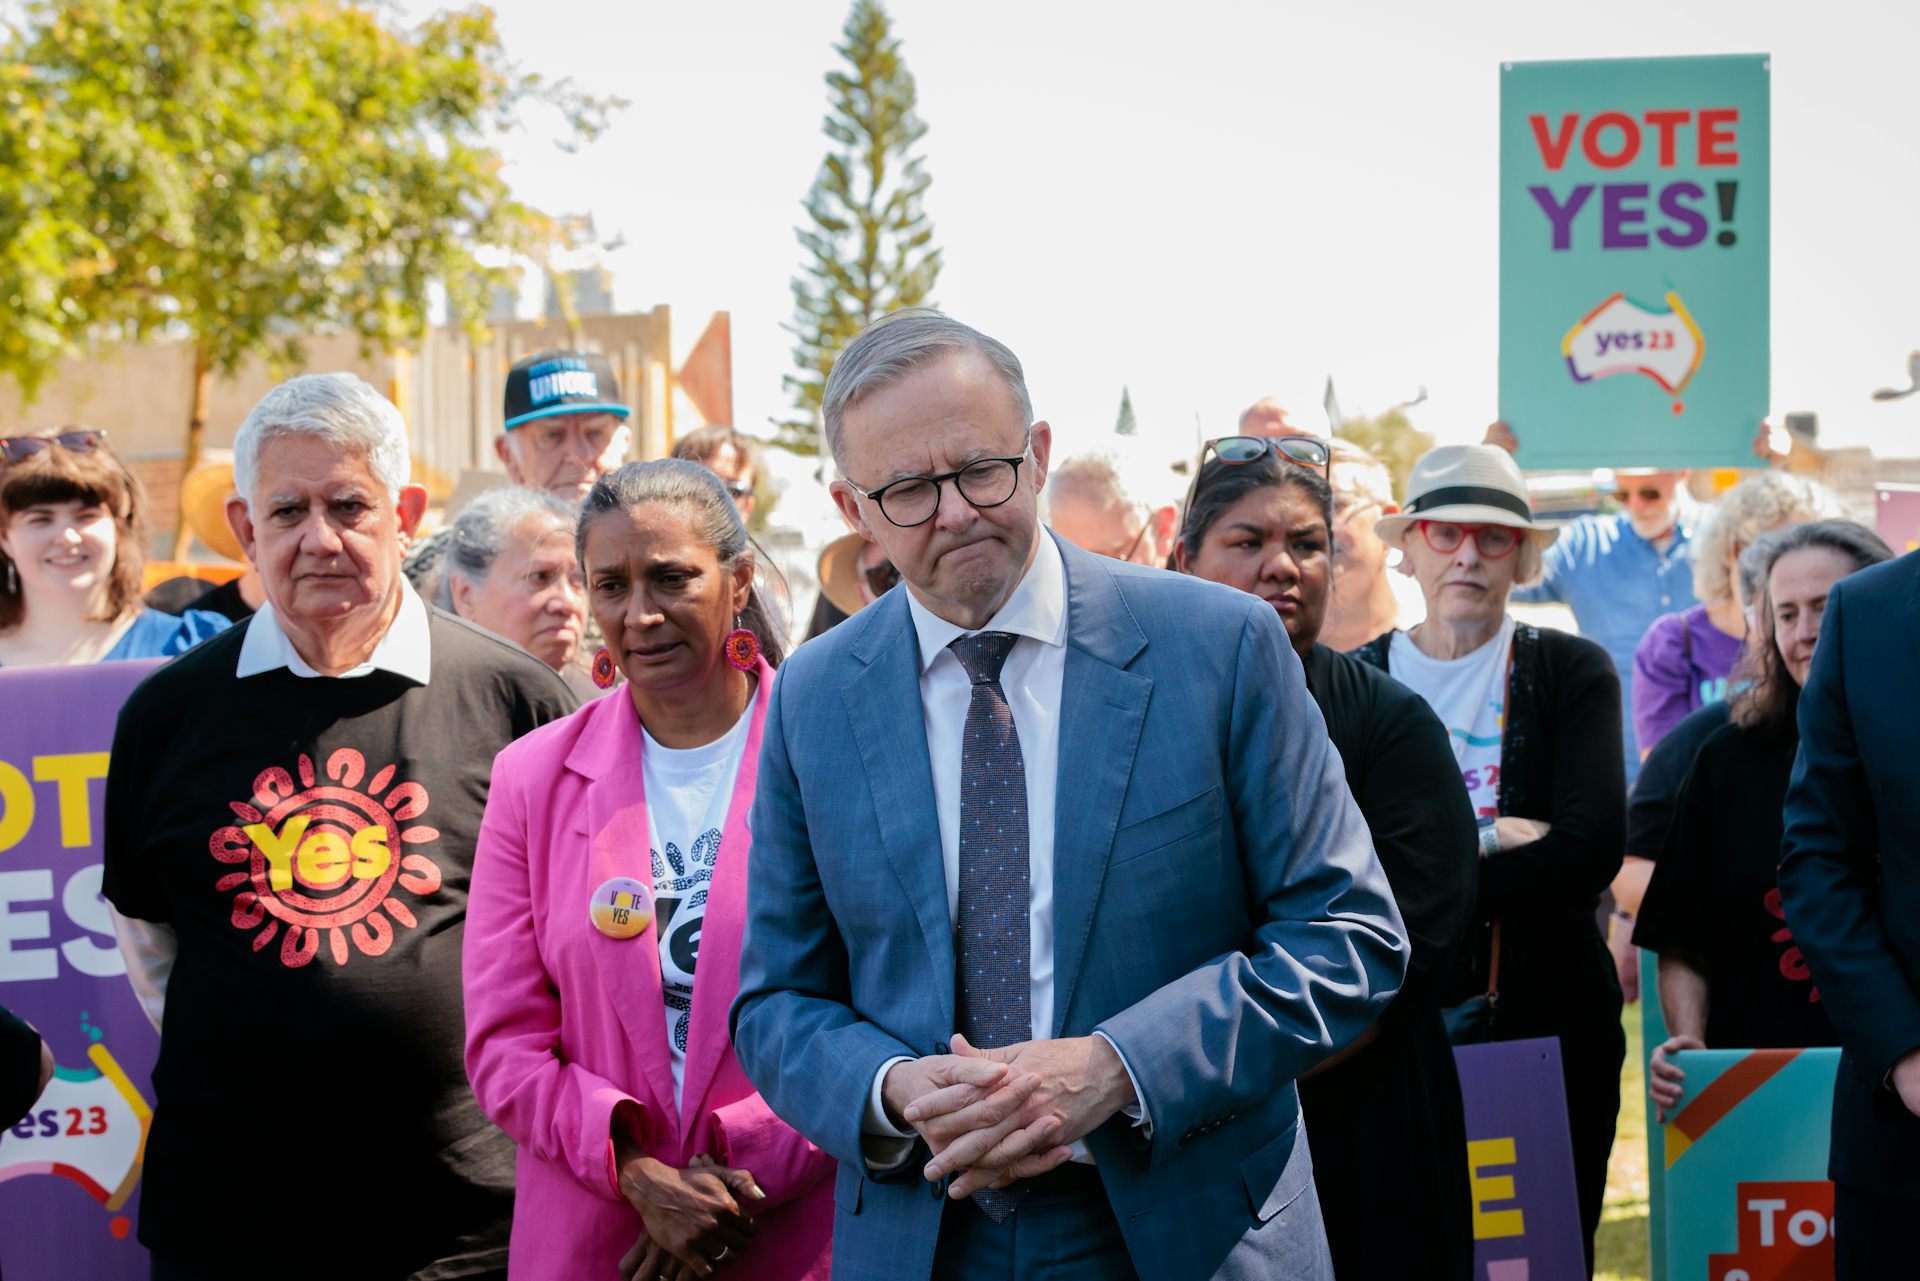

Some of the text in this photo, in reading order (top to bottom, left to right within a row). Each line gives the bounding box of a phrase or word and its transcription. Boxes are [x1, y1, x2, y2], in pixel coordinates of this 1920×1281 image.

[1529, 108, 1739, 170] VOTE
[1528, 181, 1738, 251] YES!
[242, 815, 391, 892] Yes
[612, 908, 630, 925] YES
[1747, 1199, 1835, 1246] To
